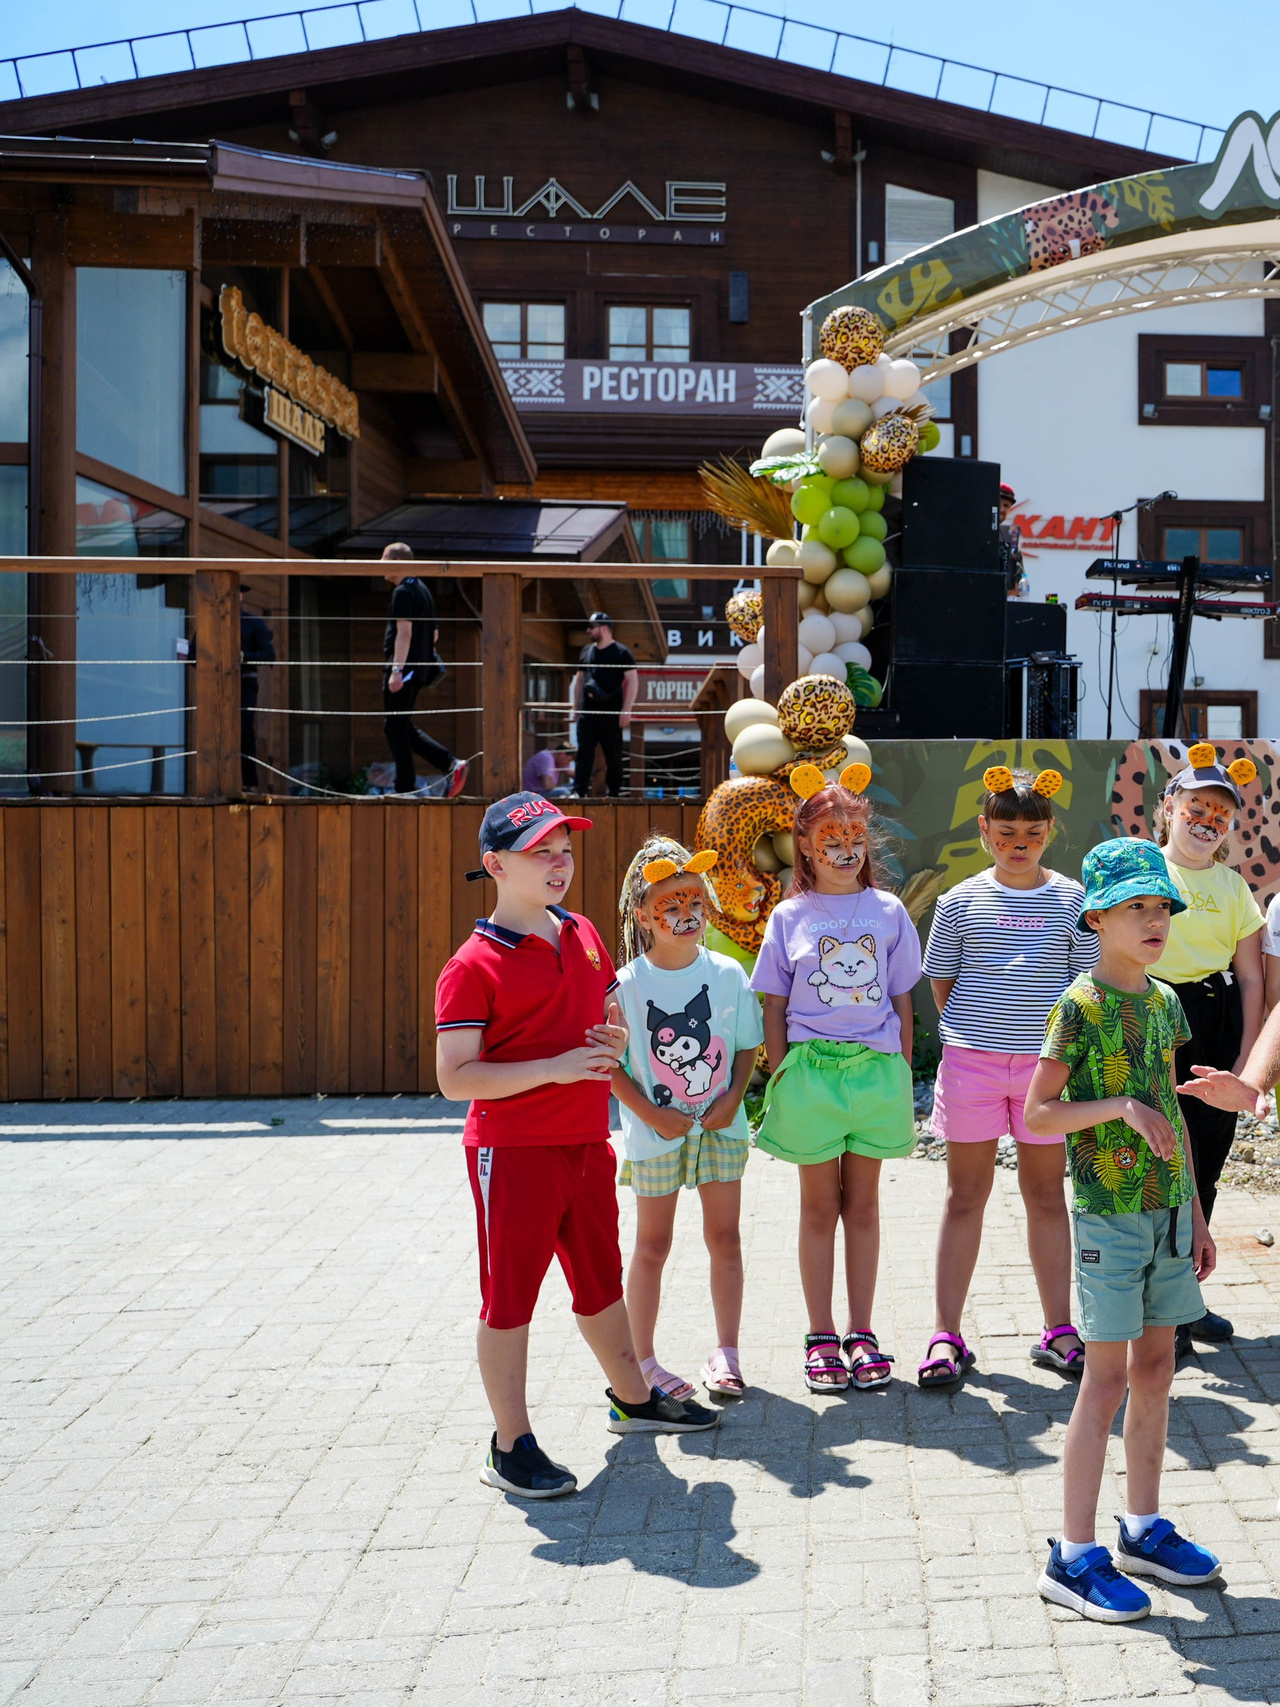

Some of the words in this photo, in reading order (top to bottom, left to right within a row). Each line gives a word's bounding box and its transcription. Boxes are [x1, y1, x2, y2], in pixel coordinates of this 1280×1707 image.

[447, 174, 727, 222] ШАЛЕ
[453, 224, 721, 243] РЕСТОРАН
[582, 365, 737, 403] РЕСТОРАН
[1181, 890, 1219, 909] OSA
[809, 919, 848, 933] GOOD
[996, 914, 1046, 929] GOOD
[480, 1147, 491, 1177] FIL
